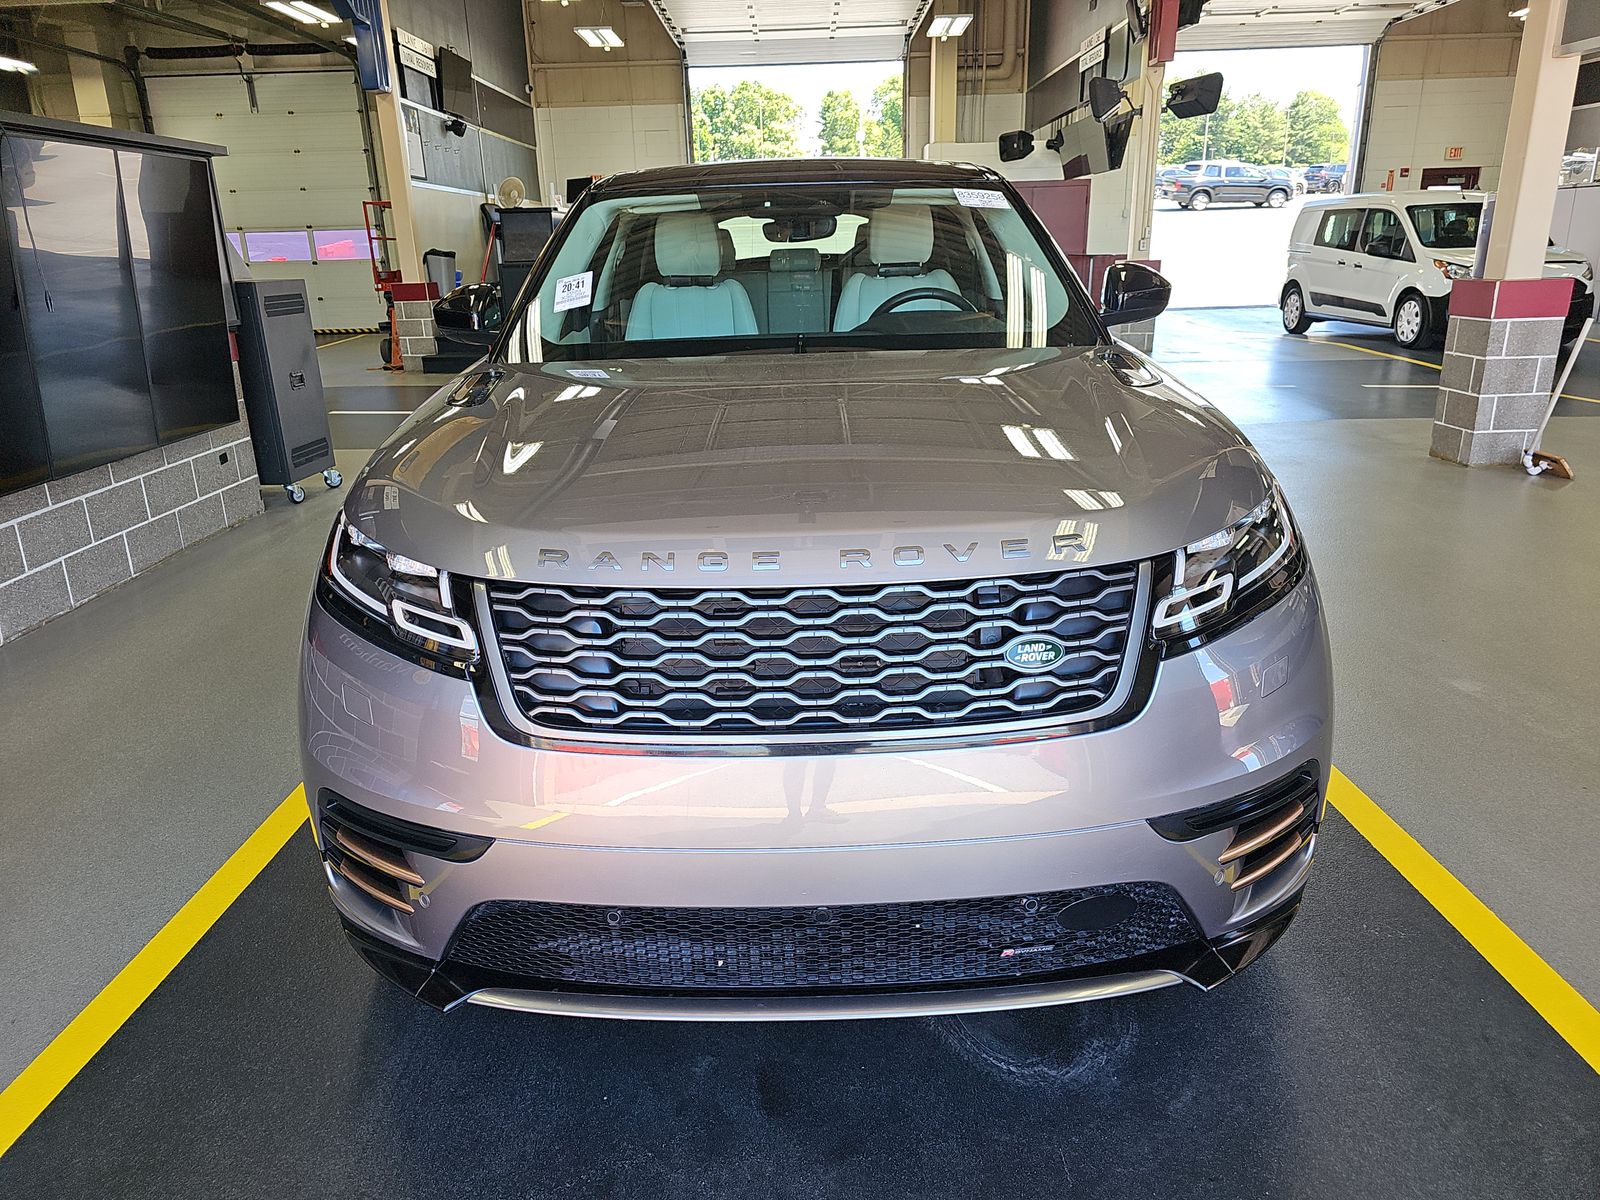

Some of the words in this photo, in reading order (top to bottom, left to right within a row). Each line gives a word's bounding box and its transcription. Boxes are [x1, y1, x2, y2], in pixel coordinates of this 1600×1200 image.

[415, 57, 435, 74] RESOURCE
[1449, 147, 1463, 158] EXIT
[562, 279, 585, 293] 20:41
[538, 548, 781, 572] RANGE
[839, 534, 1087, 568] ROVER
[1017, 643, 1046, 653] LAND
[1020, 651, 1056, 662] ROVER
